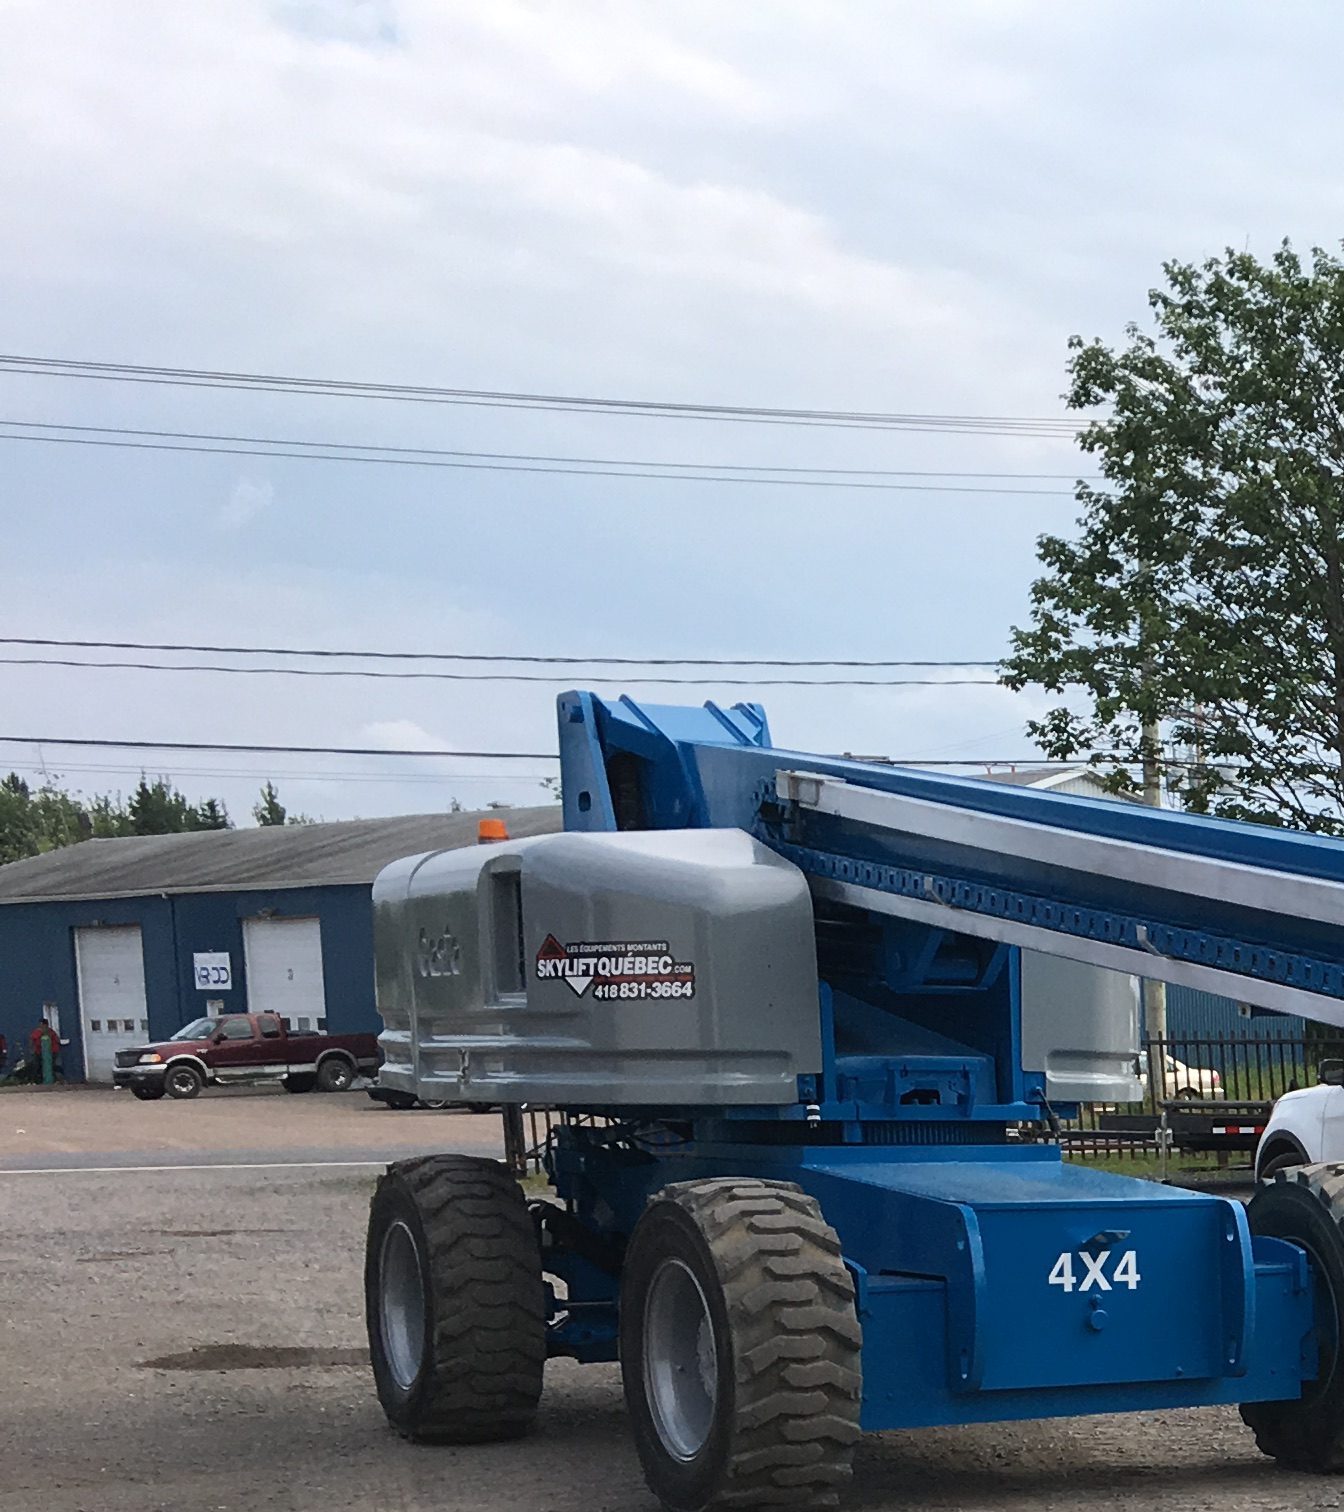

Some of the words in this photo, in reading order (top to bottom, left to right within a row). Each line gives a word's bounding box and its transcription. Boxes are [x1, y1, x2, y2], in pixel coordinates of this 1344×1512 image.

[626, 942, 668, 952] MONTANTS
[594, 984, 619, 998] 418
[618, 981, 693, 998] 831-3664
[1048, 1250, 1141, 1293] 4X4
